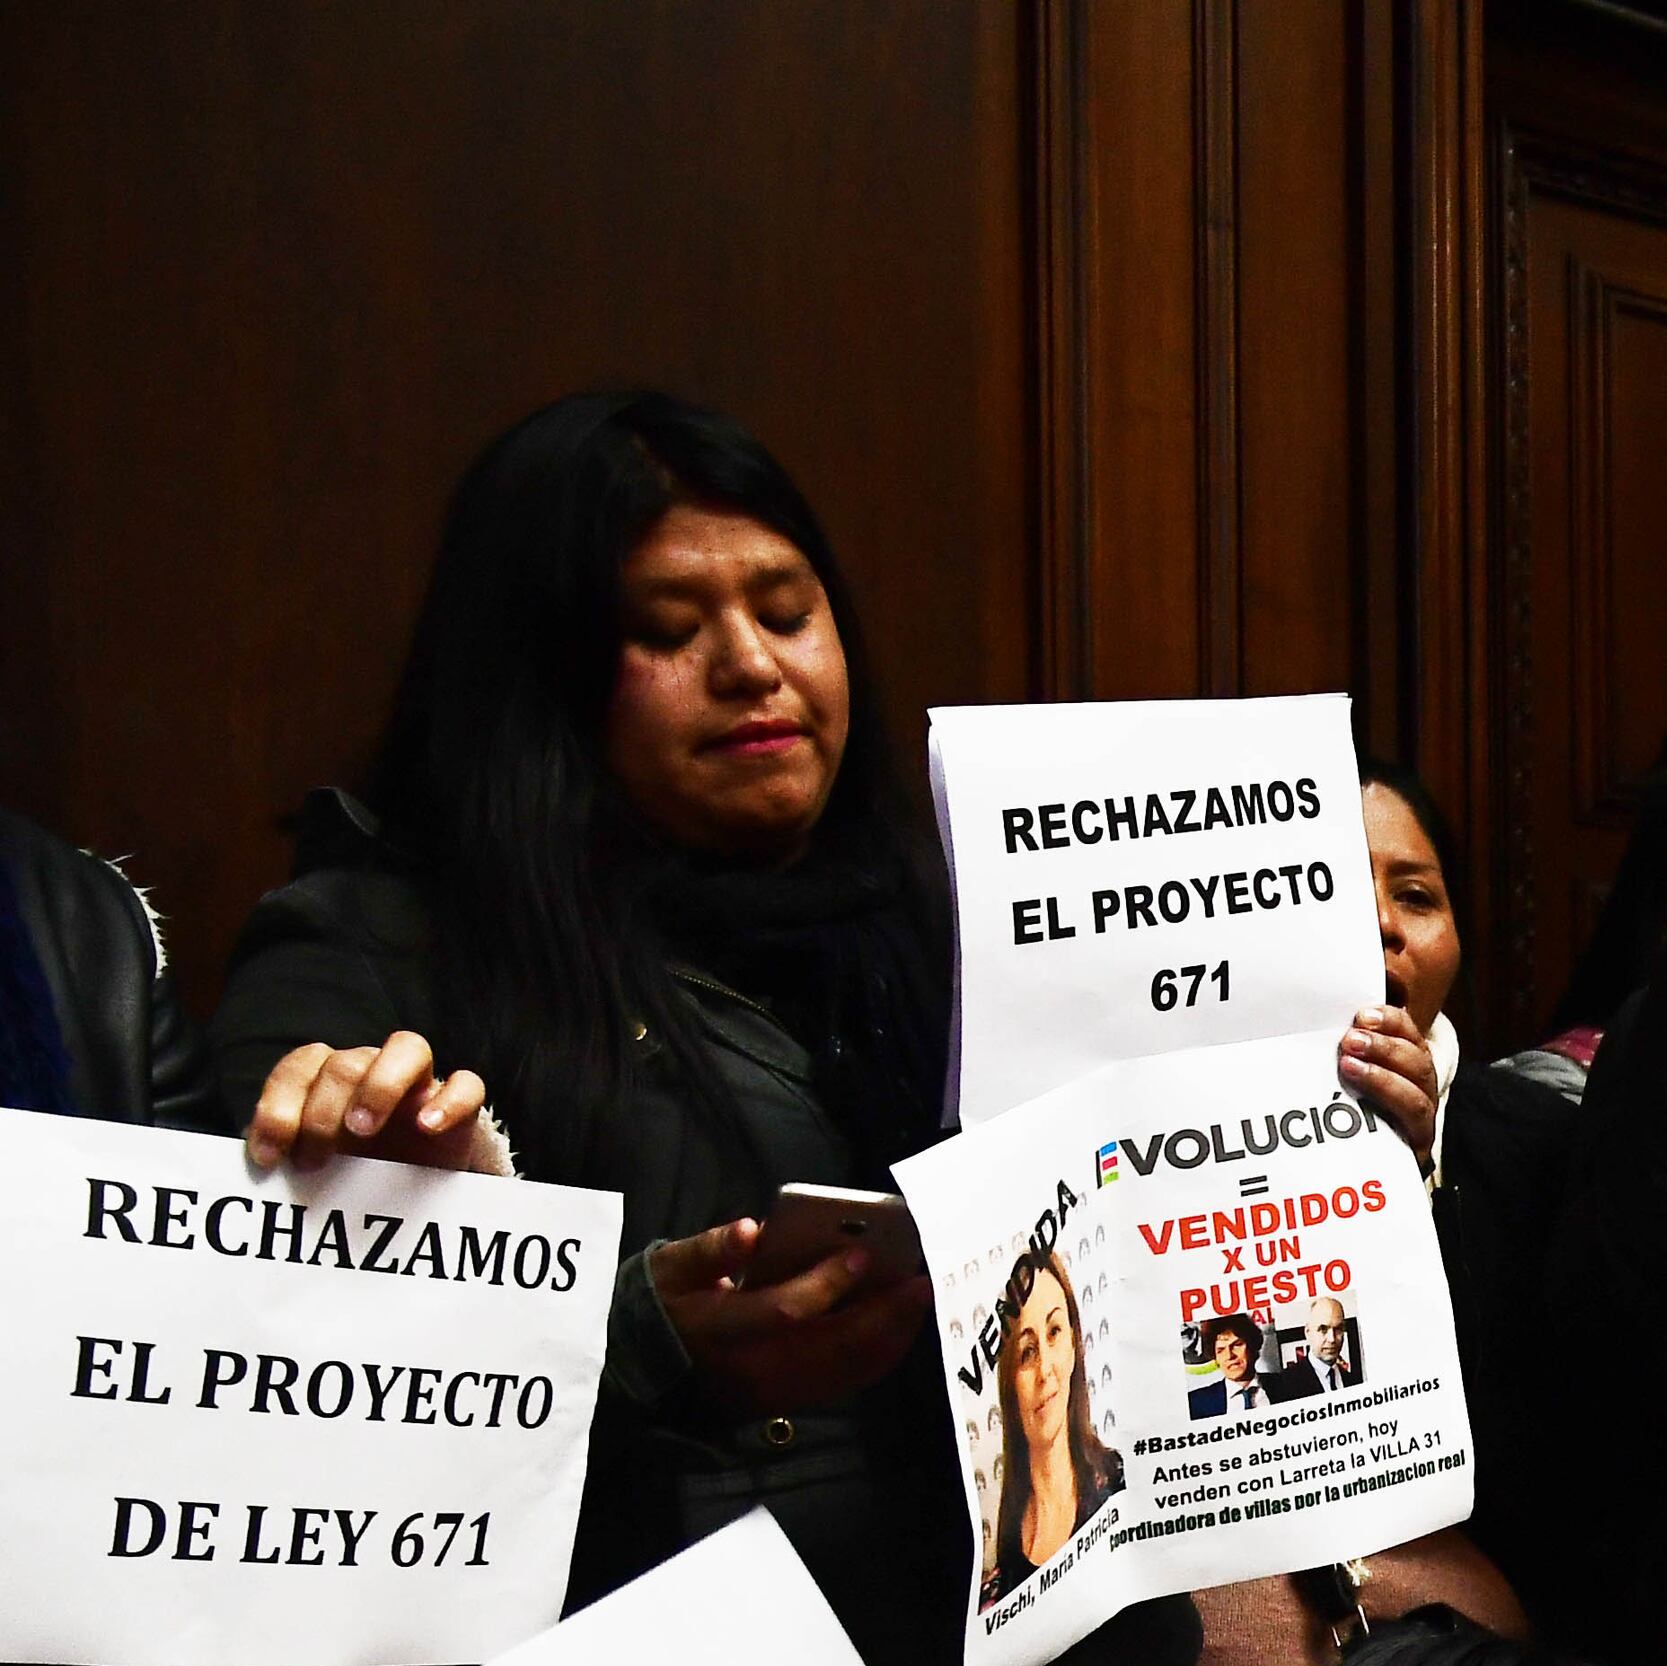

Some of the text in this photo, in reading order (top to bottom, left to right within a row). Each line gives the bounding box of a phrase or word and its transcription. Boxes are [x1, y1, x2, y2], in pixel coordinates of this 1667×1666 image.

[1002, 778, 1321, 853] RECHAZAMOS
[1012, 861, 1334, 945] EL PROYECTO
[1151, 960, 1231, 1012] 671
[82, 1177, 581, 1292] RECHAZAMOS
[1138, 1180, 1386, 1255] VENDIDOS
[1223, 1236, 1301, 1273] X UN
[1180, 1258, 1351, 1322] PUESTO
[71, 1335, 553, 1429] EL PROYECTO
[1133, 1376, 1440, 1456] #BastadeNegociosInmobiliarios
[1152, 1419, 1399, 1484] Antes se abstuvieron, hoy
[1155, 1430, 1442, 1509] venden con Larreta la VILLA 31
[1219, 1504, 1242, 1525] de
[1244, 1495, 1292, 1521] villas
[1294, 1489, 1322, 1513] por
[1325, 1484, 1341, 1503] la
[1438, 1449, 1466, 1475] real
[108, 1497, 491, 1568] DE LEY 671
[984, 1588, 1035, 1636] Vischi,
[1076, 1507, 1120, 1561] Patricia
